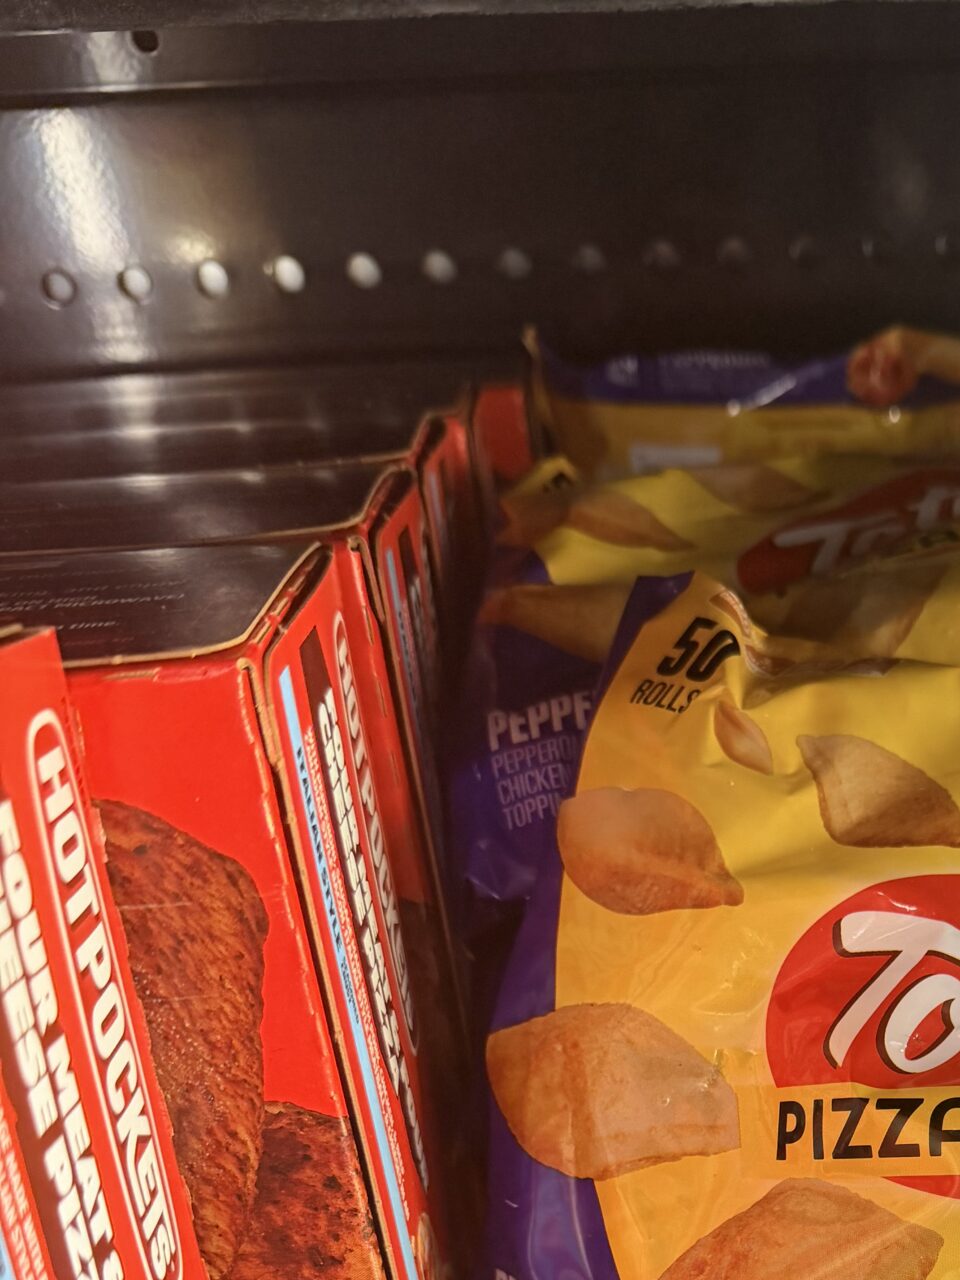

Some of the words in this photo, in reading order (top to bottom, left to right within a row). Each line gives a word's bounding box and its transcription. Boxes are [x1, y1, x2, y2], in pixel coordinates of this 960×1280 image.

[338, 637, 368, 770] HOT
[630, 679, 700, 714] ROLLS
[656, 616, 741, 682] 50
[37, 745, 100, 926] HOT
[490, 735, 577, 779] PEPPERO
[296, 746, 324, 864] ITALIAN
[320, 868, 344, 952] STYLE
[318, 702, 367, 927] CHEESE
[362, 926, 400, 1097] PIZZA
[324, 687, 359, 846] FOUR
[356, 852, 392, 1006] MEAT
[0, 799, 58, 1037] FOUR
[47, 1032, 114, 1247] MEAT
[6, 1150, 29, 1220] MADE
[22, 1214, 46, 1278] WITH
